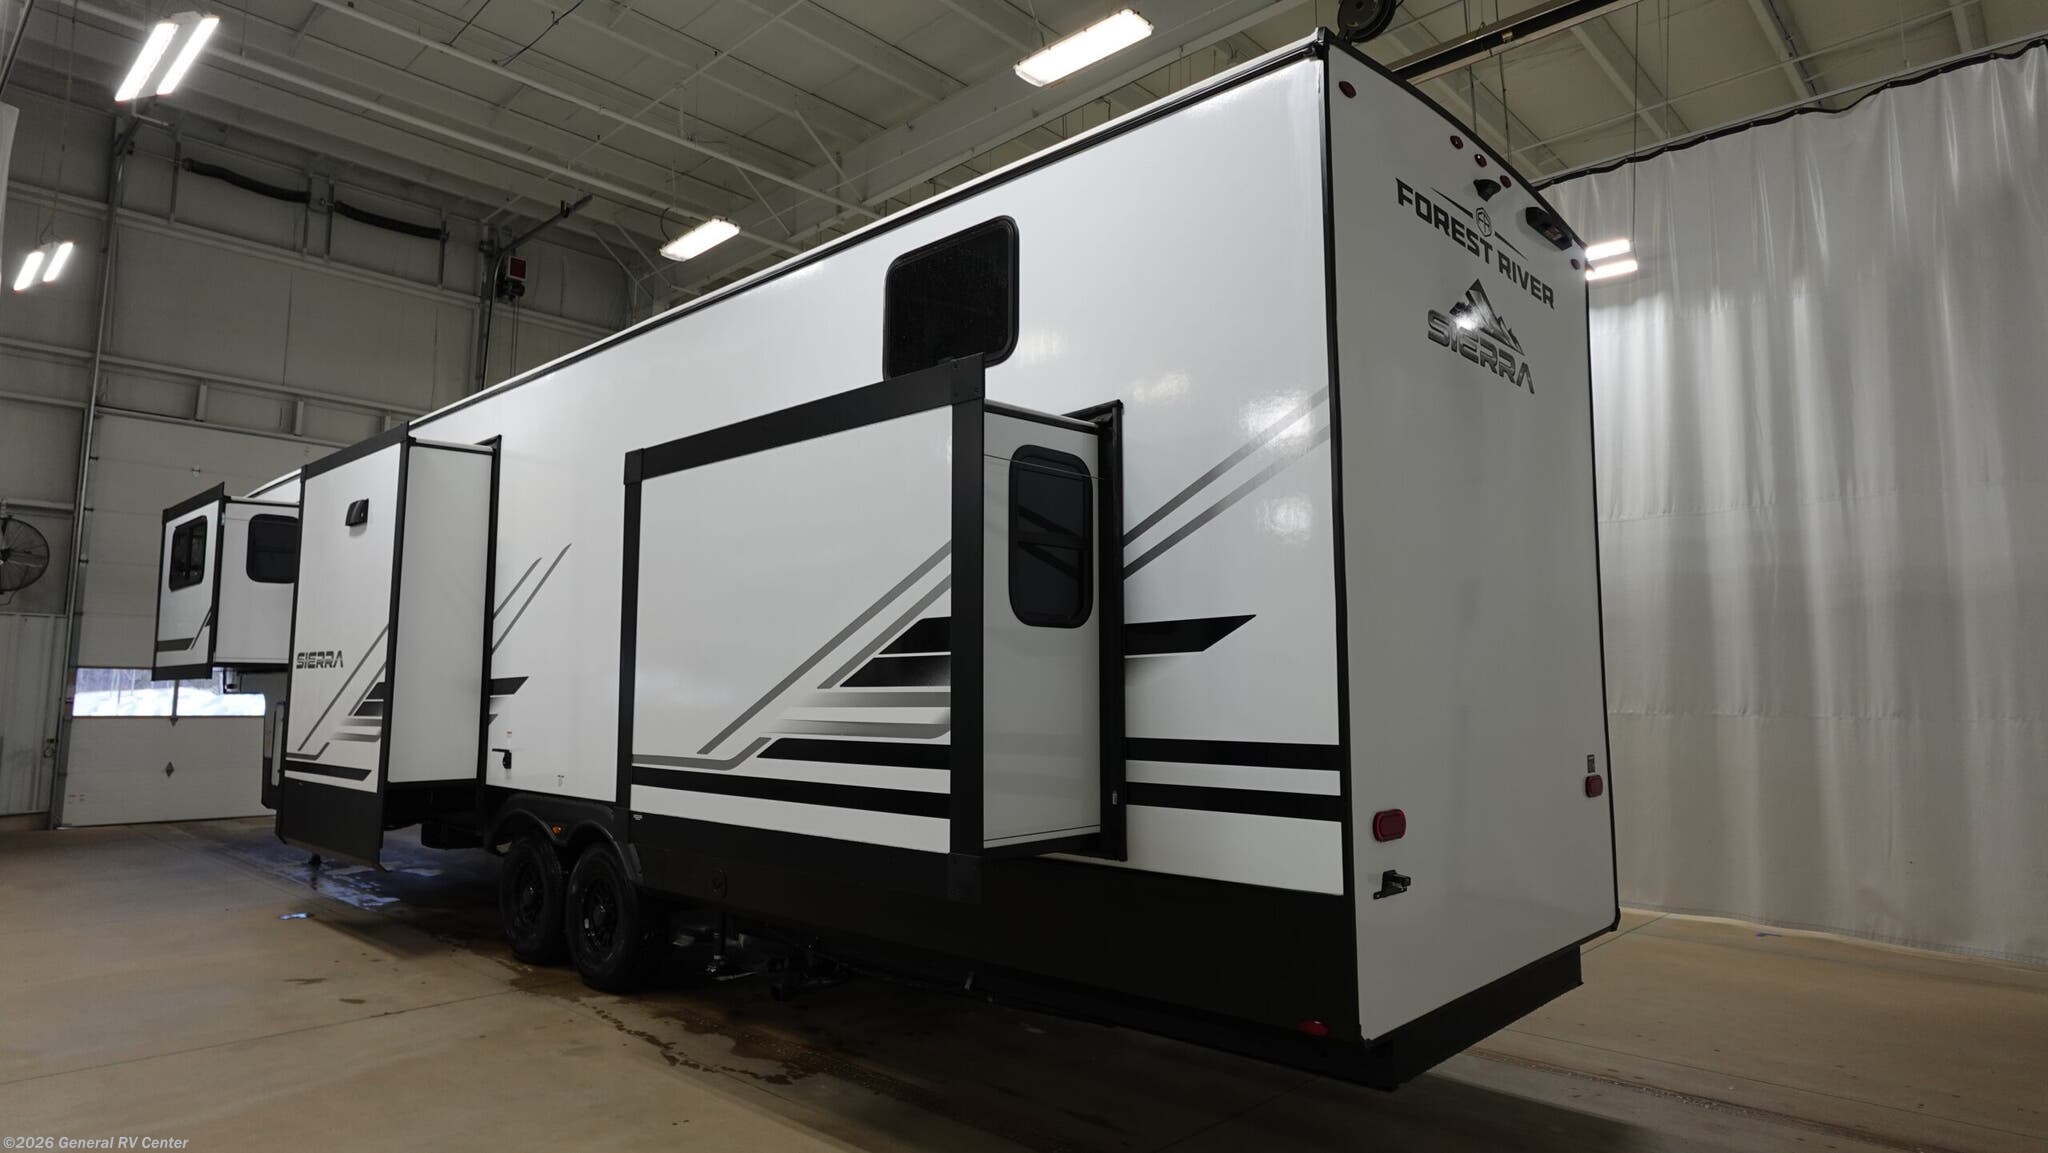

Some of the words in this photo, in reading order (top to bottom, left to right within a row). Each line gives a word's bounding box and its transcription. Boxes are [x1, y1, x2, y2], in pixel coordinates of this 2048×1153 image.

[1396, 178, 1493, 264] FOREST
[1498, 250, 1555, 310] RIVER
[1428, 309, 1535, 395] SIERRA
[296, 650, 343, 669] SIERRA
